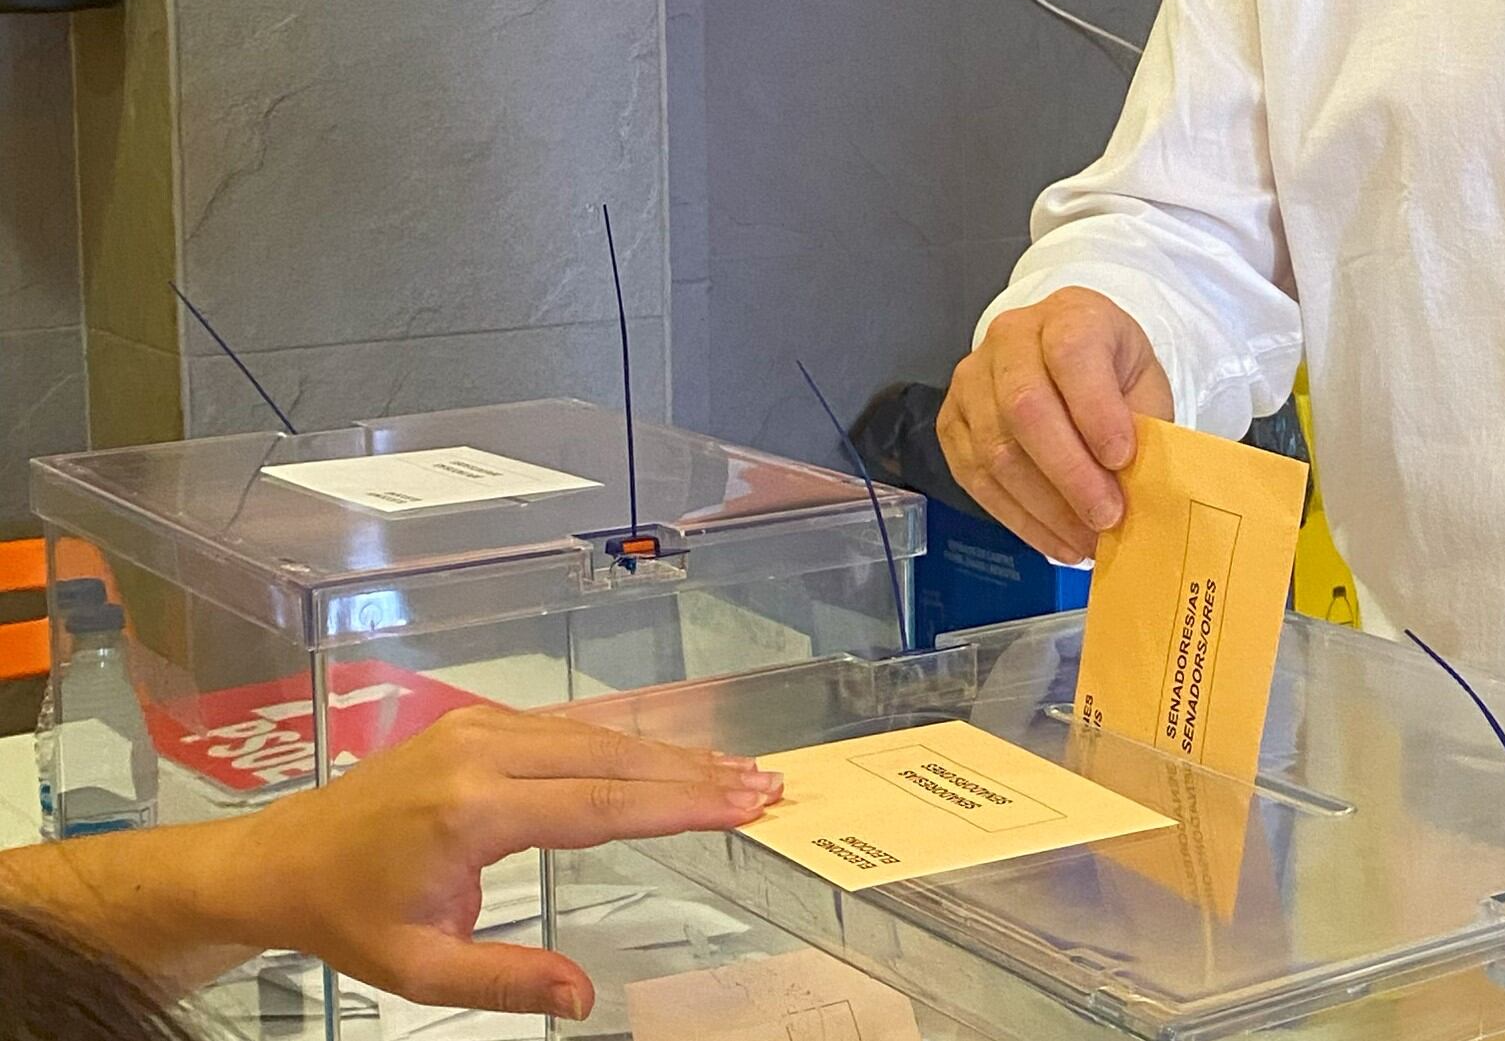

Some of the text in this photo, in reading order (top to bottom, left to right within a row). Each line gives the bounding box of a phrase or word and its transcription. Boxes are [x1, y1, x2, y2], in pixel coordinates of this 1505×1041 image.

[1166, 581, 1200, 739] SENADORES/AS
[1181, 578, 1217, 755] SENADORS/ORES
[811, 838, 878, 870] ELECCIONES
